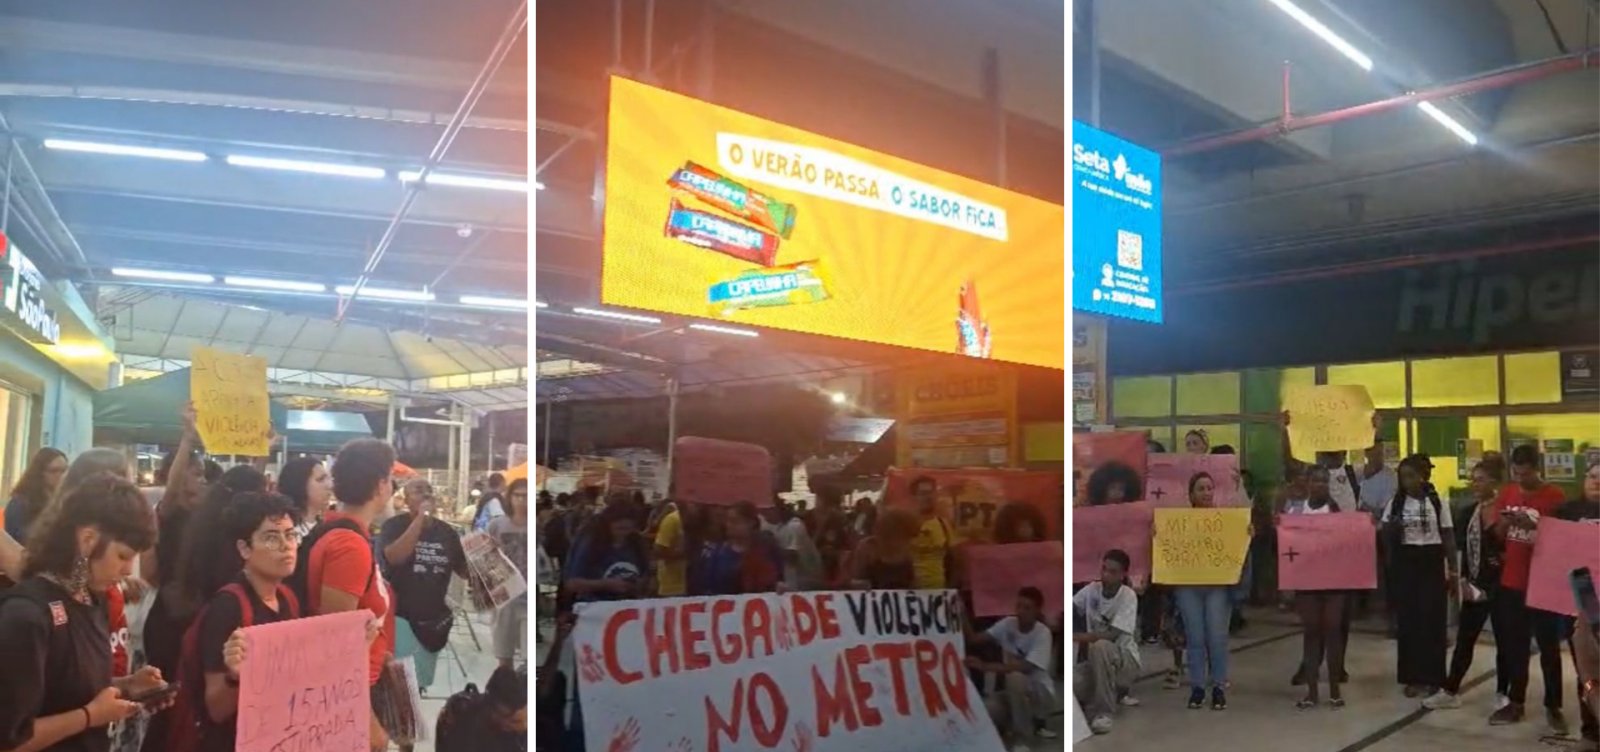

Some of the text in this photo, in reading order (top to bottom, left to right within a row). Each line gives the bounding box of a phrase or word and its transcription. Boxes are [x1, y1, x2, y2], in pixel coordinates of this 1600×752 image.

[729, 143, 744, 165] O
[752, 149, 817, 184] VERÃO
[891, 185, 903, 205] O
[909, 190, 961, 220] SABOR
[1073, 143, 1111, 174] Seta
[603, 598, 775, 685] CHEGA
[790, 594, 841, 646] DE
[705, 639, 975, 752] NO METRO
